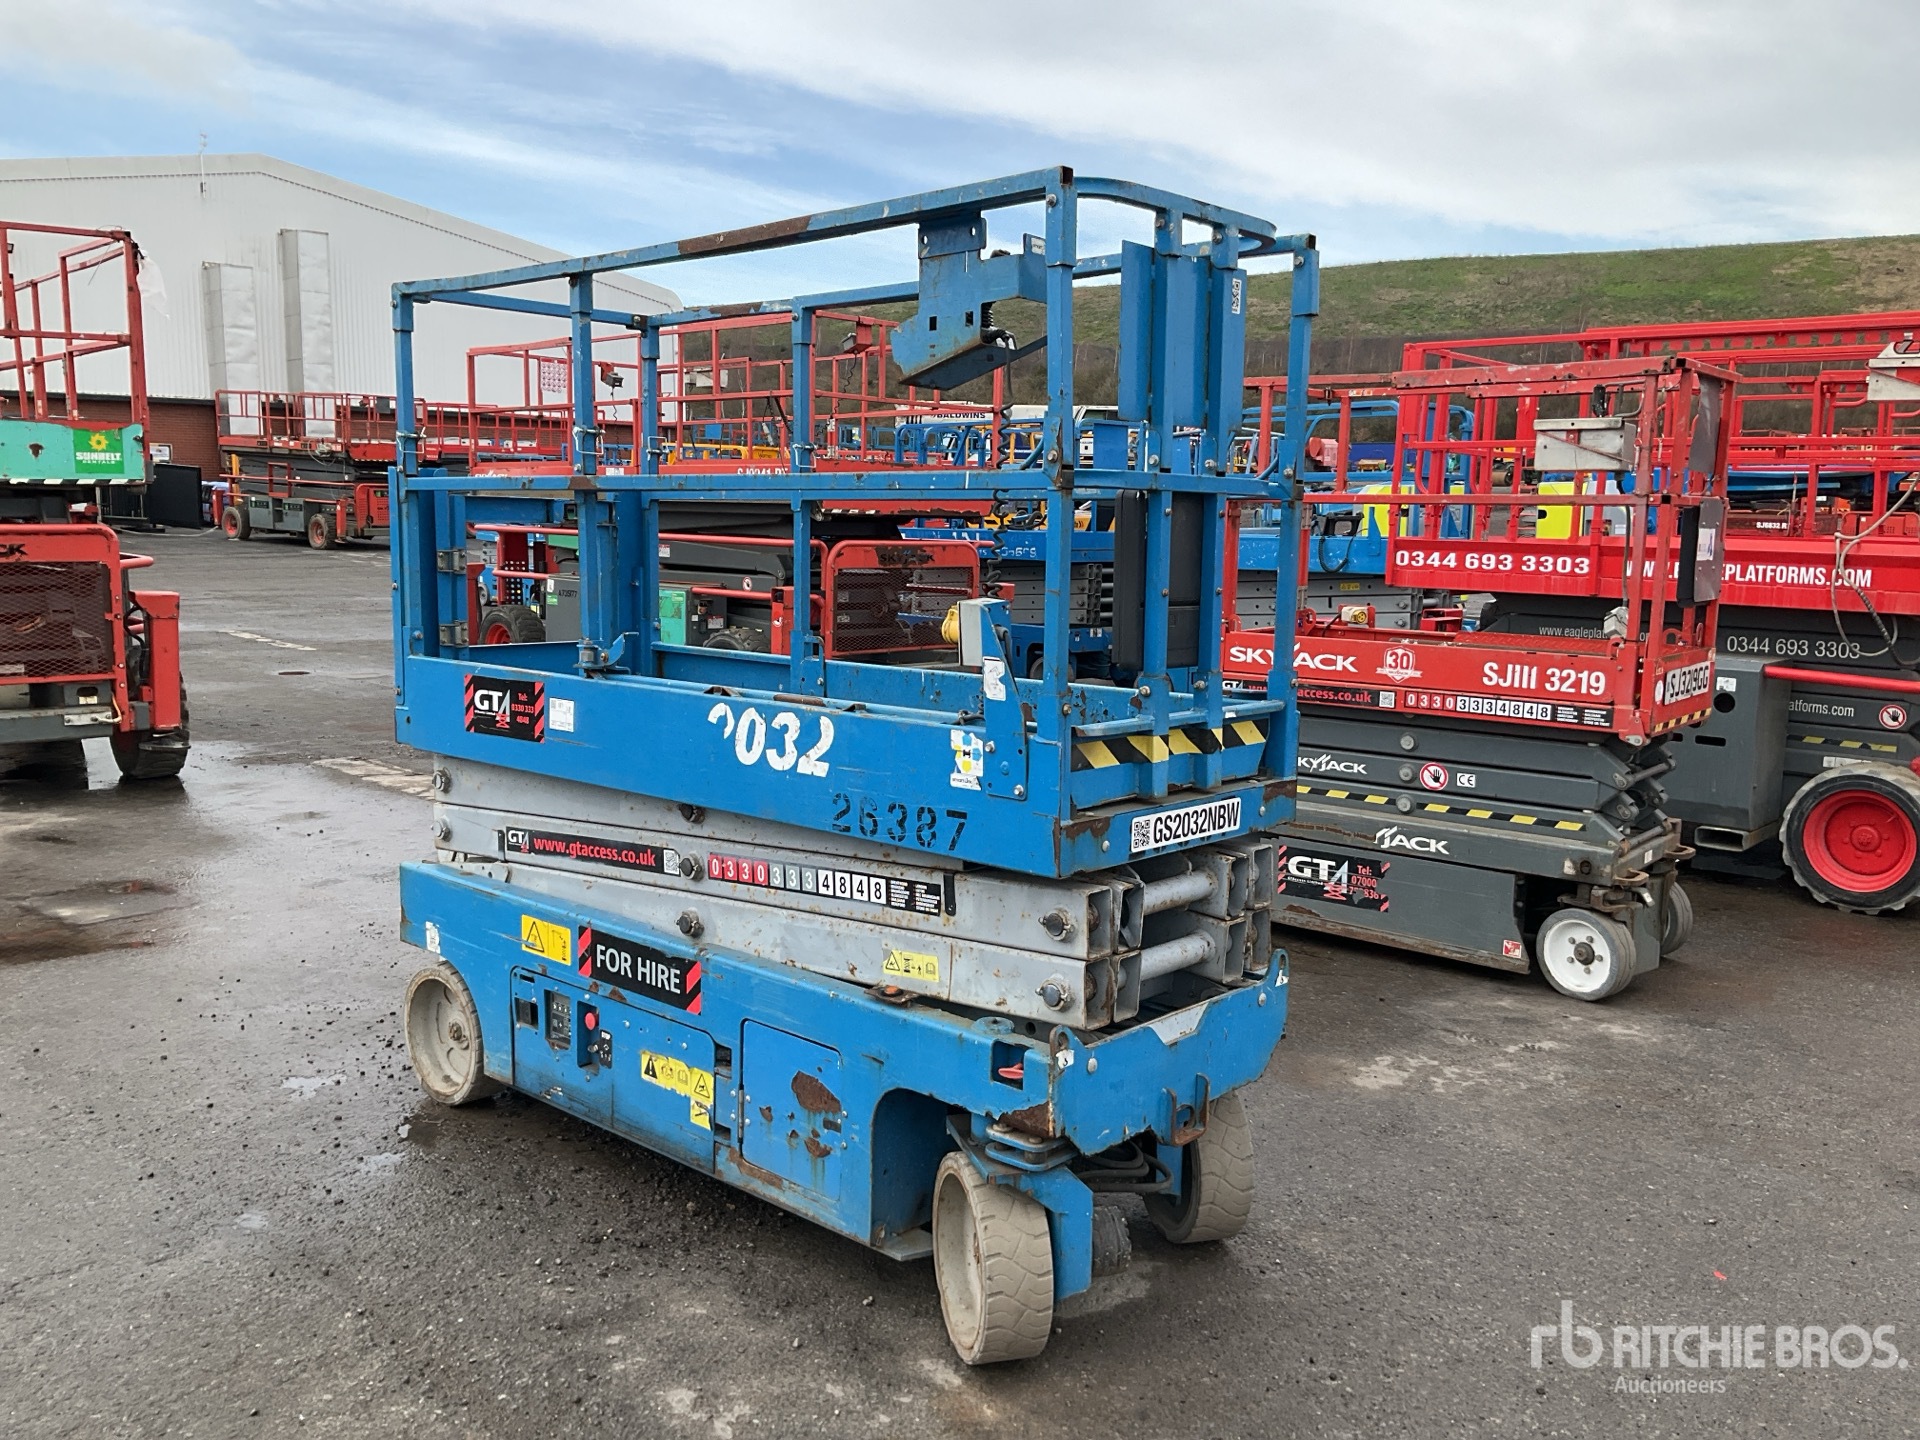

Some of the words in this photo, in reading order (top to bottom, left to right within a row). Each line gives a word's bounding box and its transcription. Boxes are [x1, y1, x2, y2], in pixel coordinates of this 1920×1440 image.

[75, 451, 122, 461] SUNBELT
[1395, 550, 1457, 568] 0344
[1465, 553, 1513, 571] 693
[1521, 555, 1590, 574] 3303
[1726, 636, 1770, 653] 0344
[1775, 638, 1809, 655] 693
[1814, 640, 1861, 659] 3303
[1388, 651, 1411, 669] 30
[1544, 667, 1606, 696] 3219
[1788, 699, 1855, 718] atforms.com
[831, 792, 968, 851] 26387
[1153, 801, 1240, 844] GS2032NBW
[533, 837, 656, 868] www.gtaccess.co.uk
[1351, 875, 1377, 888] 07000
[1357, 864, 1373, 876] Tel:
[595, 943, 633, 979] FOR
[637, 955, 682, 995] HIRE
